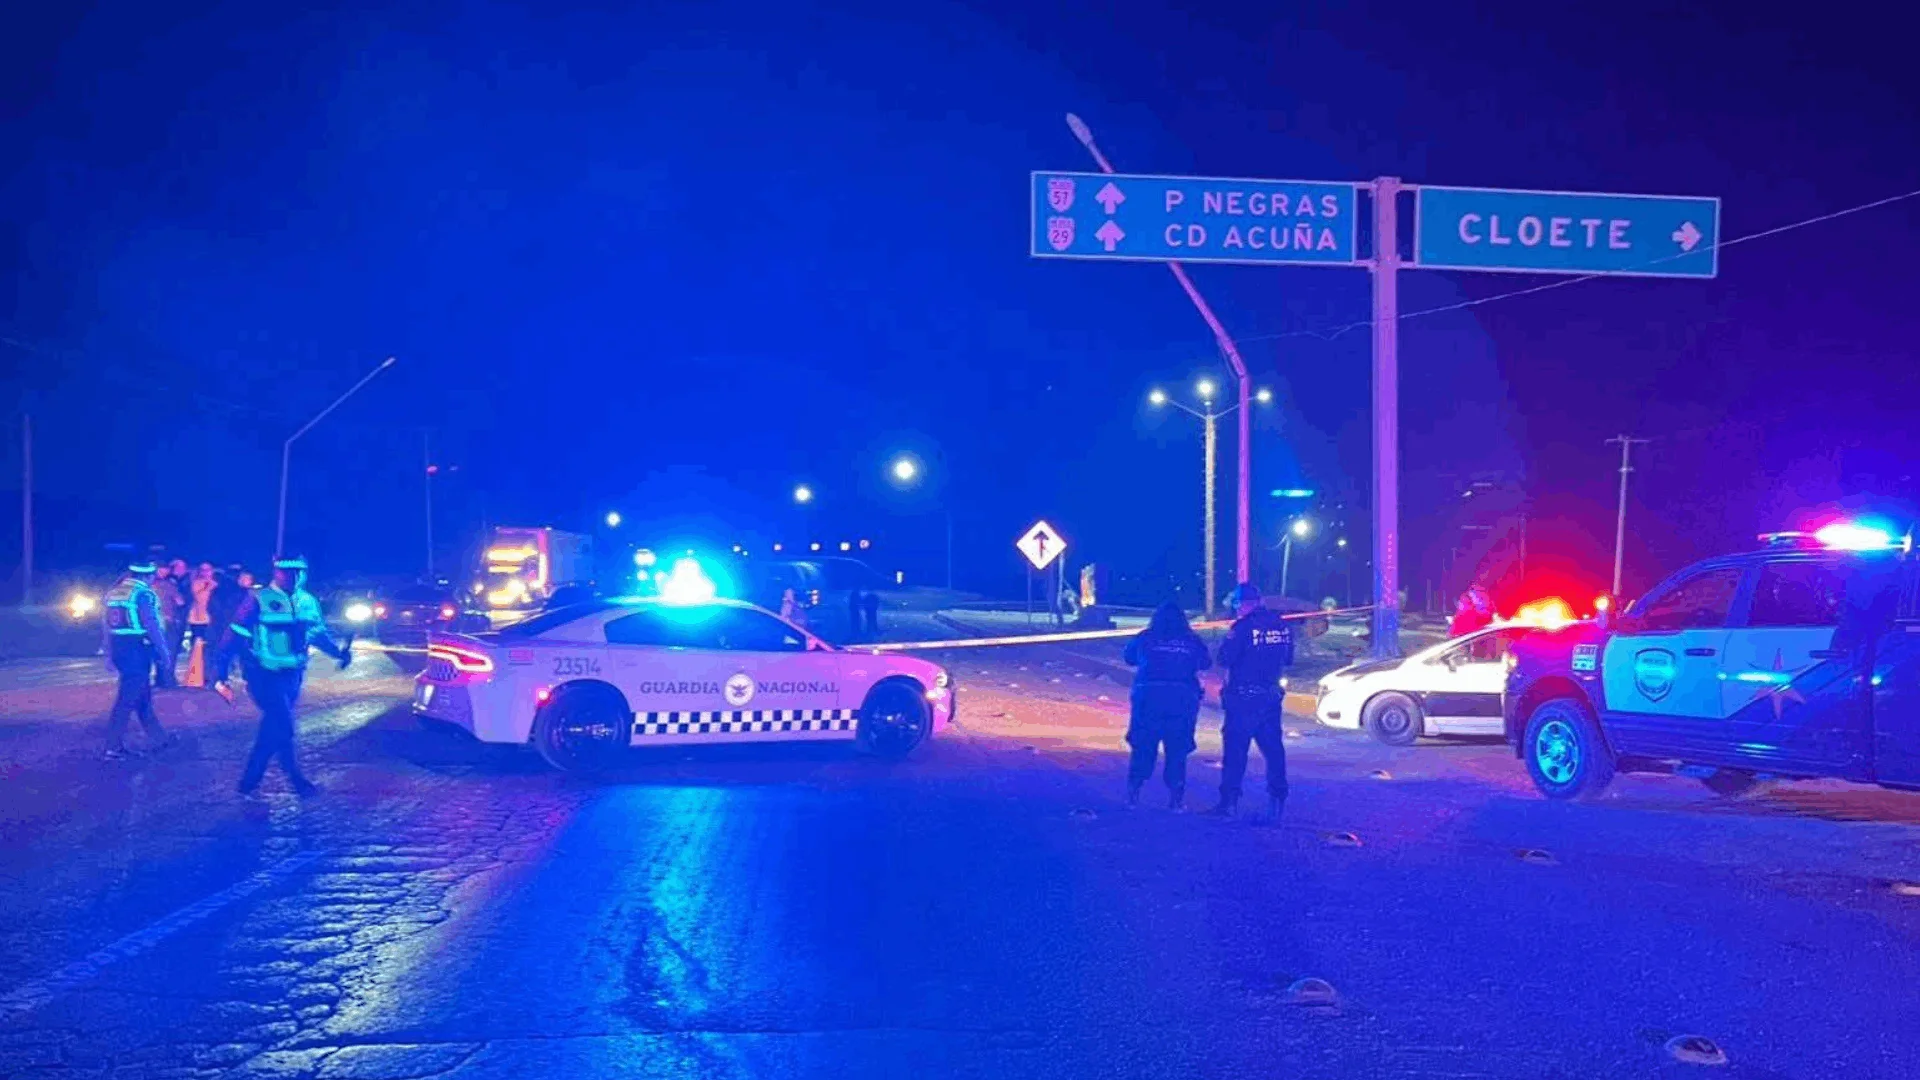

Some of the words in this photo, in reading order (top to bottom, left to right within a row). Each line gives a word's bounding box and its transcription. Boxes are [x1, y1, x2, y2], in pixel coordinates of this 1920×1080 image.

[1166, 190, 1184, 213] P
[1203, 191, 1339, 218] NEGRAS
[1052, 229, 1069, 243] 29
[1165, 223, 1207, 248] CD
[1223, 223, 1338, 251] ACUÑA
[1458, 213, 1632, 250] CLOETE
[553, 656, 602, 676] 23514
[640, 681, 720, 694] GUARDIA
[757, 681, 840, 694] NACIONAL
